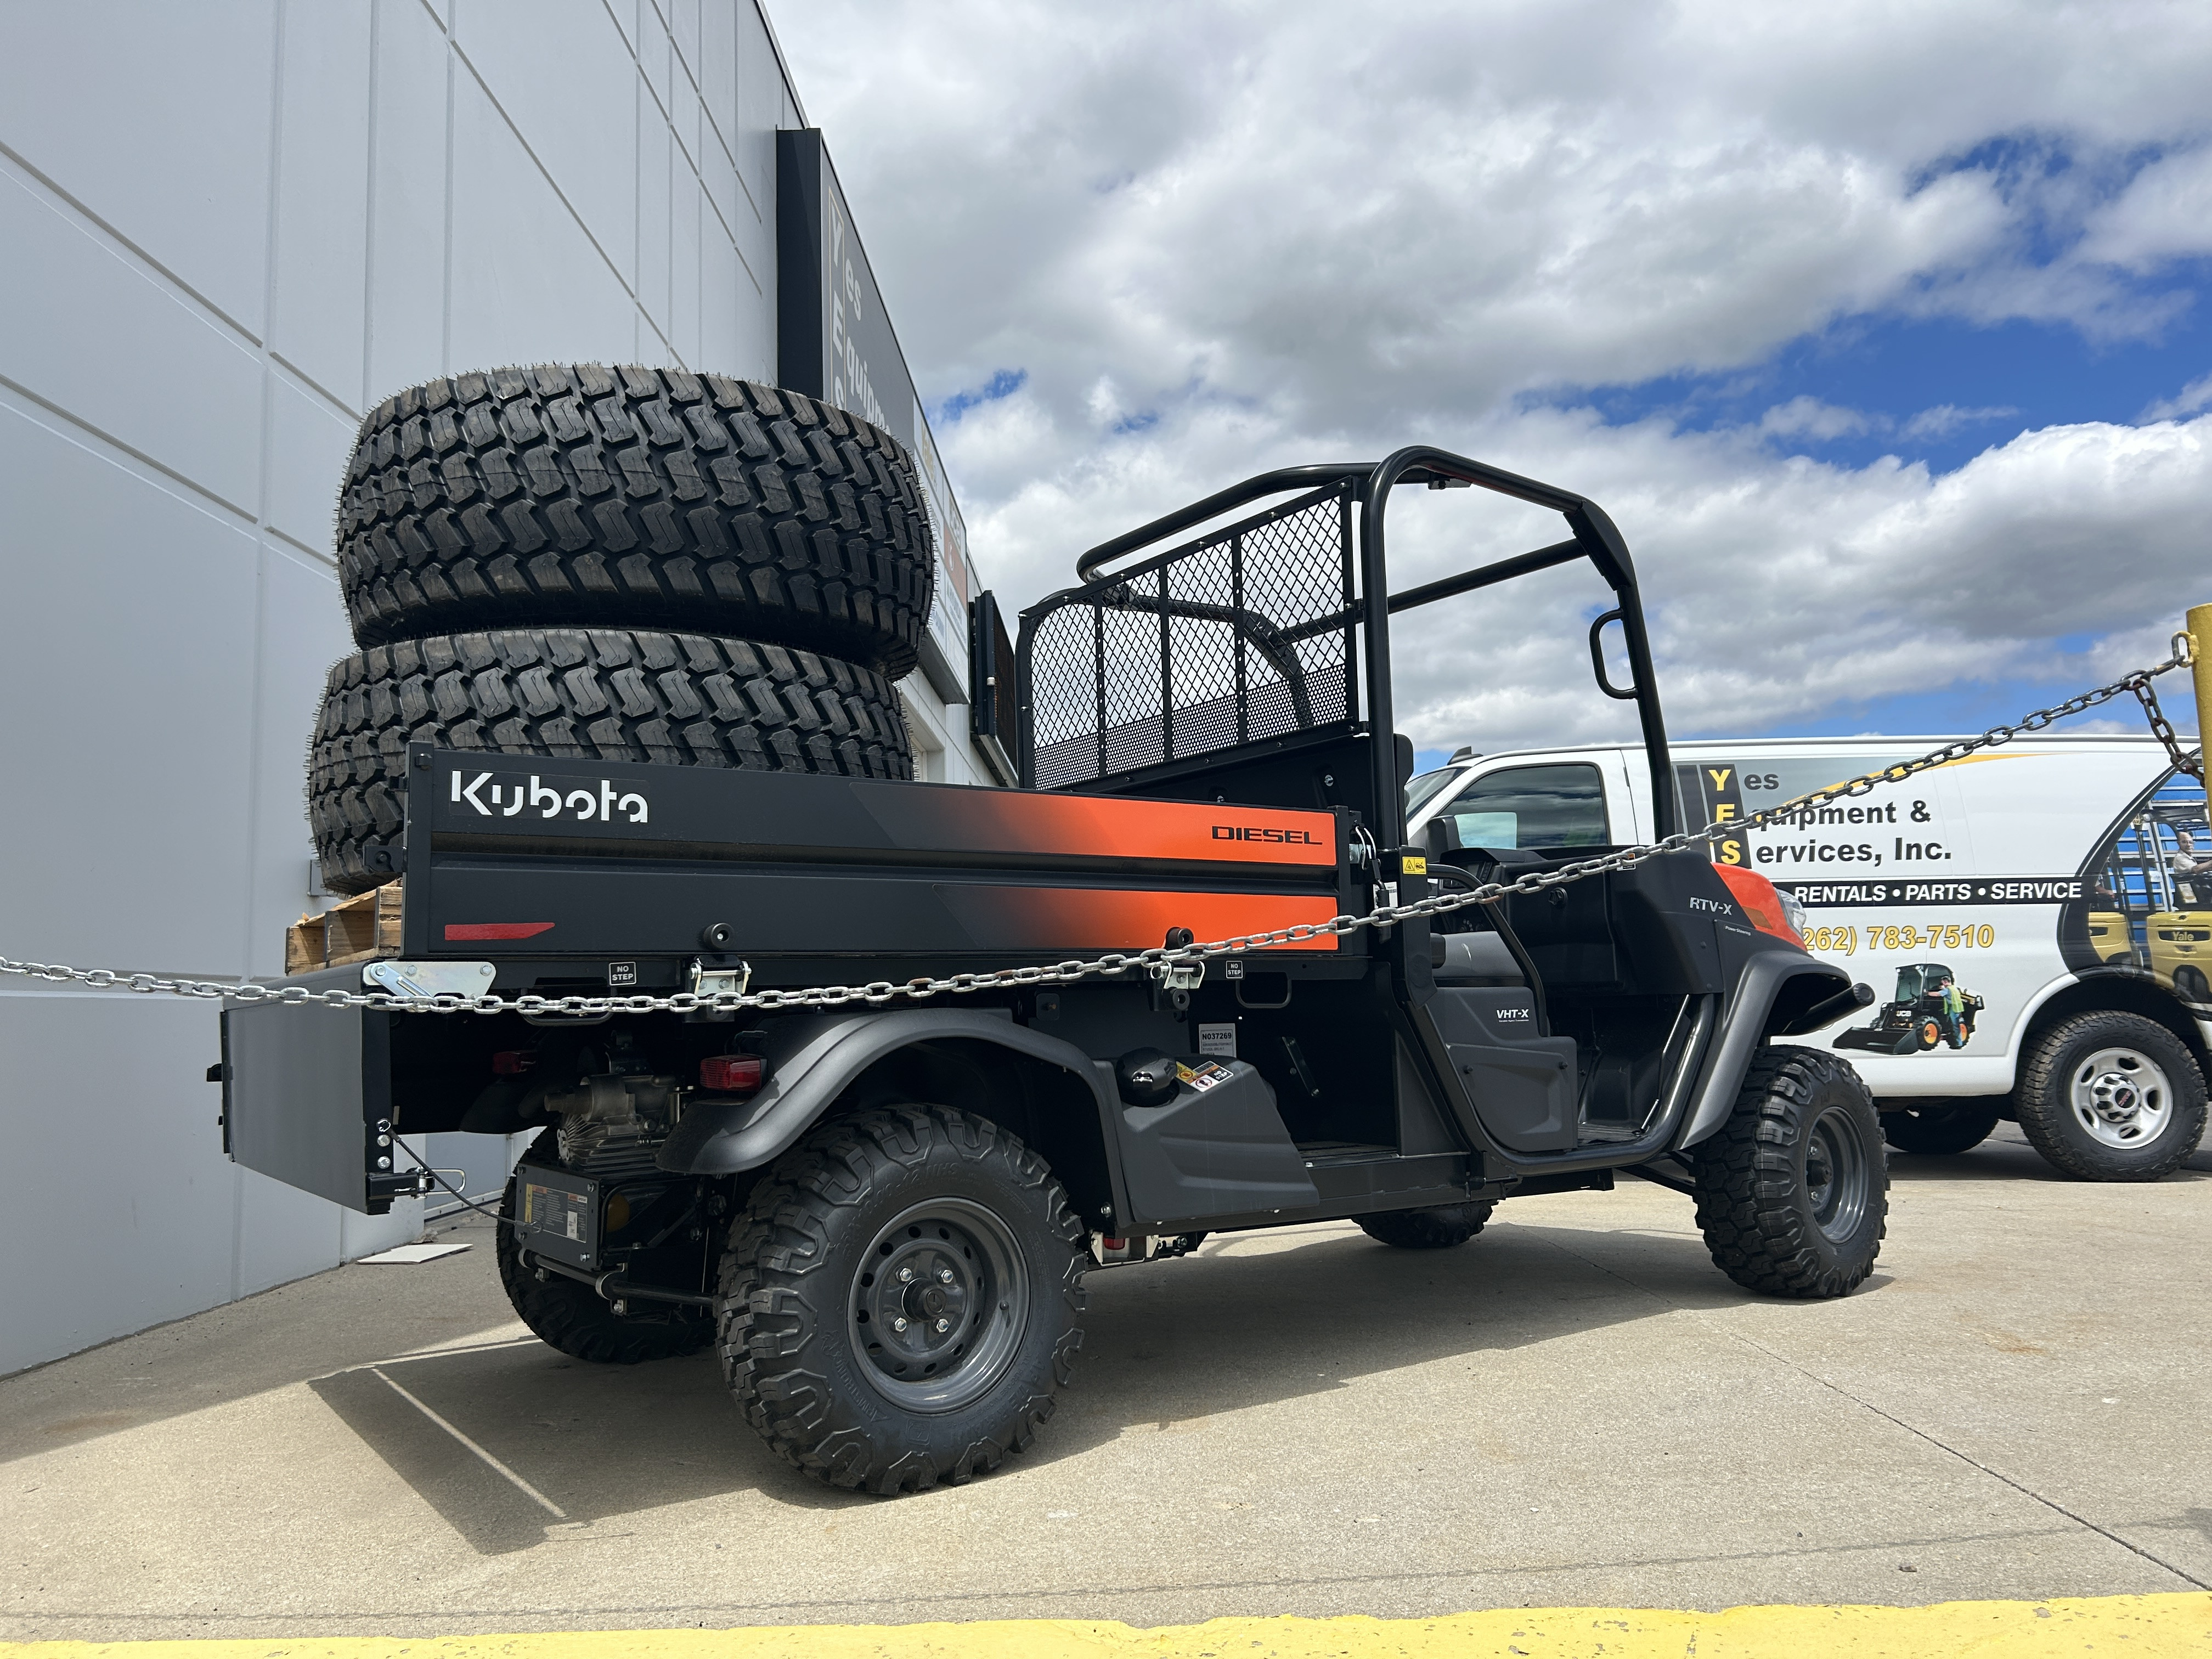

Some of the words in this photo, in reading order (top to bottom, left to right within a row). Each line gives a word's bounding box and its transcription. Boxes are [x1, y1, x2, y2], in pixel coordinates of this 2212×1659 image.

[450, 770, 648, 823] Kubota
[1910, 800, 1932, 823] &
[1211, 825, 1323, 845] DIESEL
[1894, 837, 1951, 860] Inc.
[1794, 885, 1887, 903] RENTALS
[1905, 883, 1972, 901] PARTS
[1990, 882, 2083, 900] SERVICE
[1690, 896, 1732, 916] RTV-X
[1867, 924, 1995, 950] 783-7510
[2172, 932, 2194, 941] Yale
[1496, 1009, 1529, 1019] VHT-X
